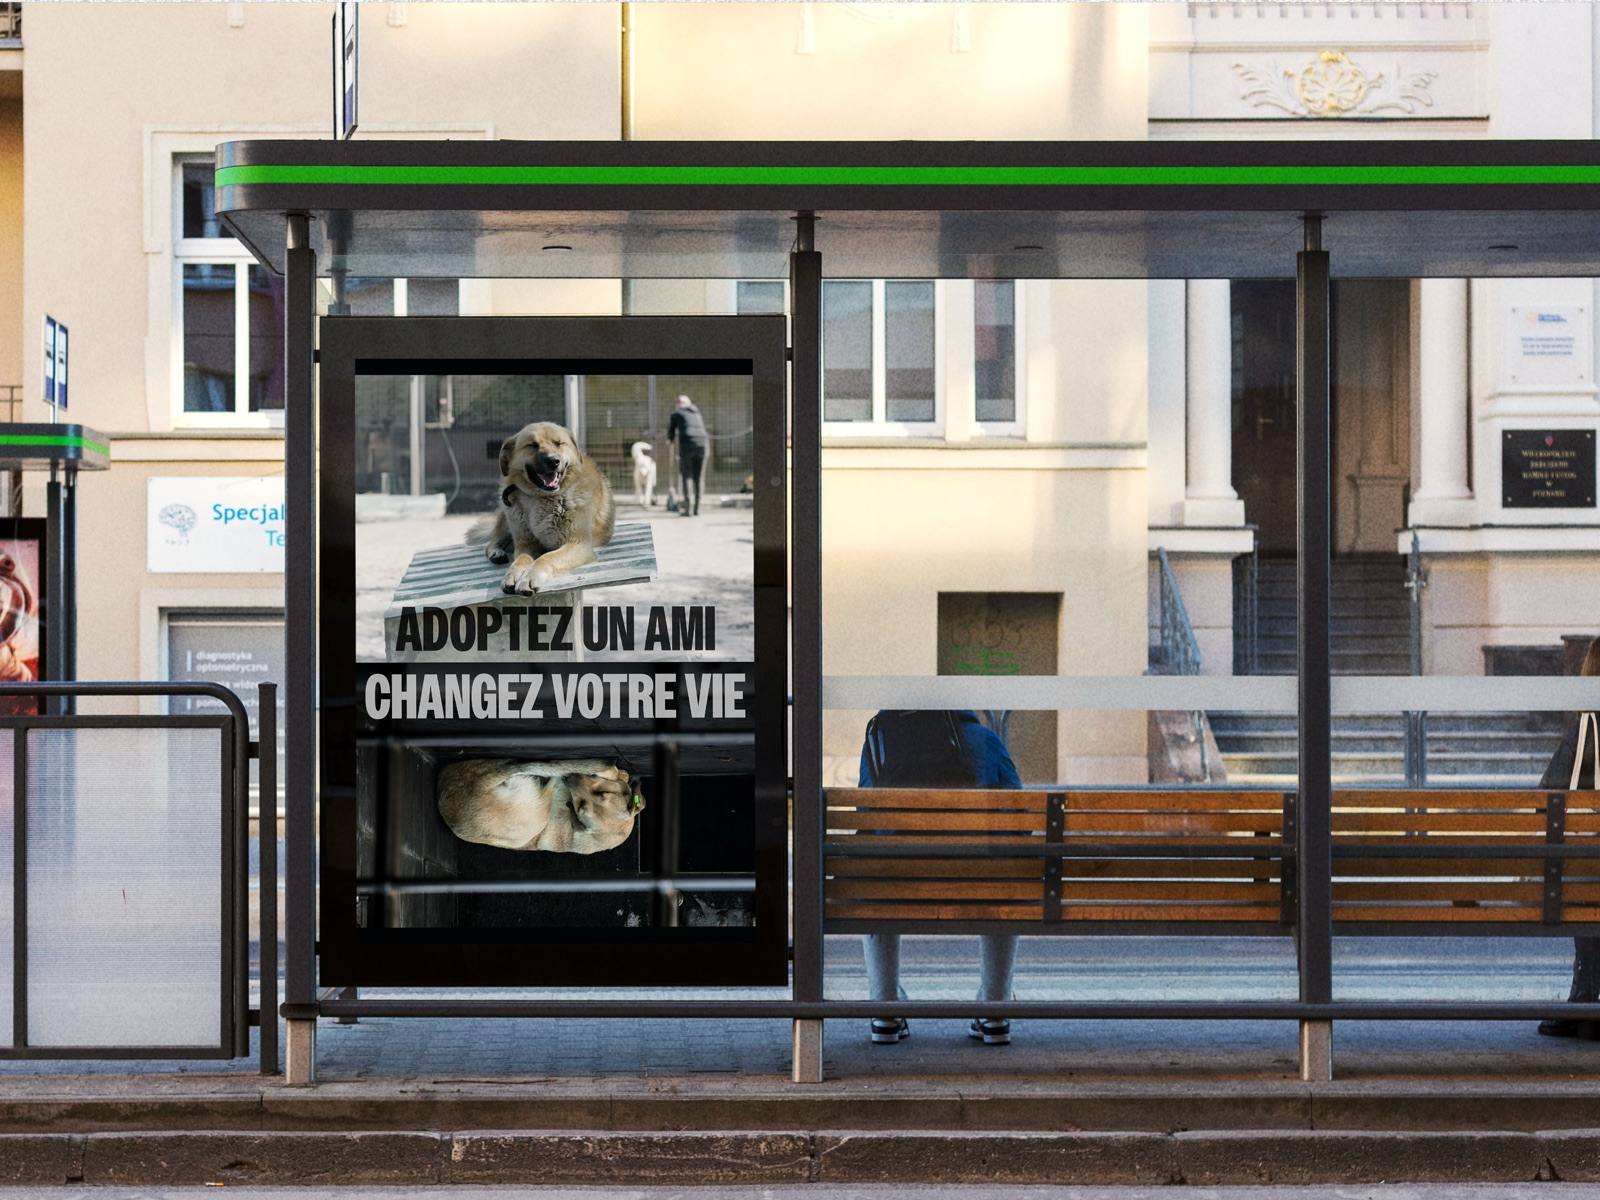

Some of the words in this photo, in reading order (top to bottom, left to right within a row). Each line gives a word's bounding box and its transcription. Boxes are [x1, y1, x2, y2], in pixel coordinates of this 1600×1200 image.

[395, 605, 574, 652] ADOPTEZ
[582, 605, 635, 652] UN
[644, 605, 716, 652] AMI
[196, 651, 253, 662] diagnostyka
[196, 663, 268, 673] optometryczna
[364, 672, 544, 720] CHANGEZ
[551, 672, 677, 720] VOTRE
[684, 672, 747, 720] VIE
